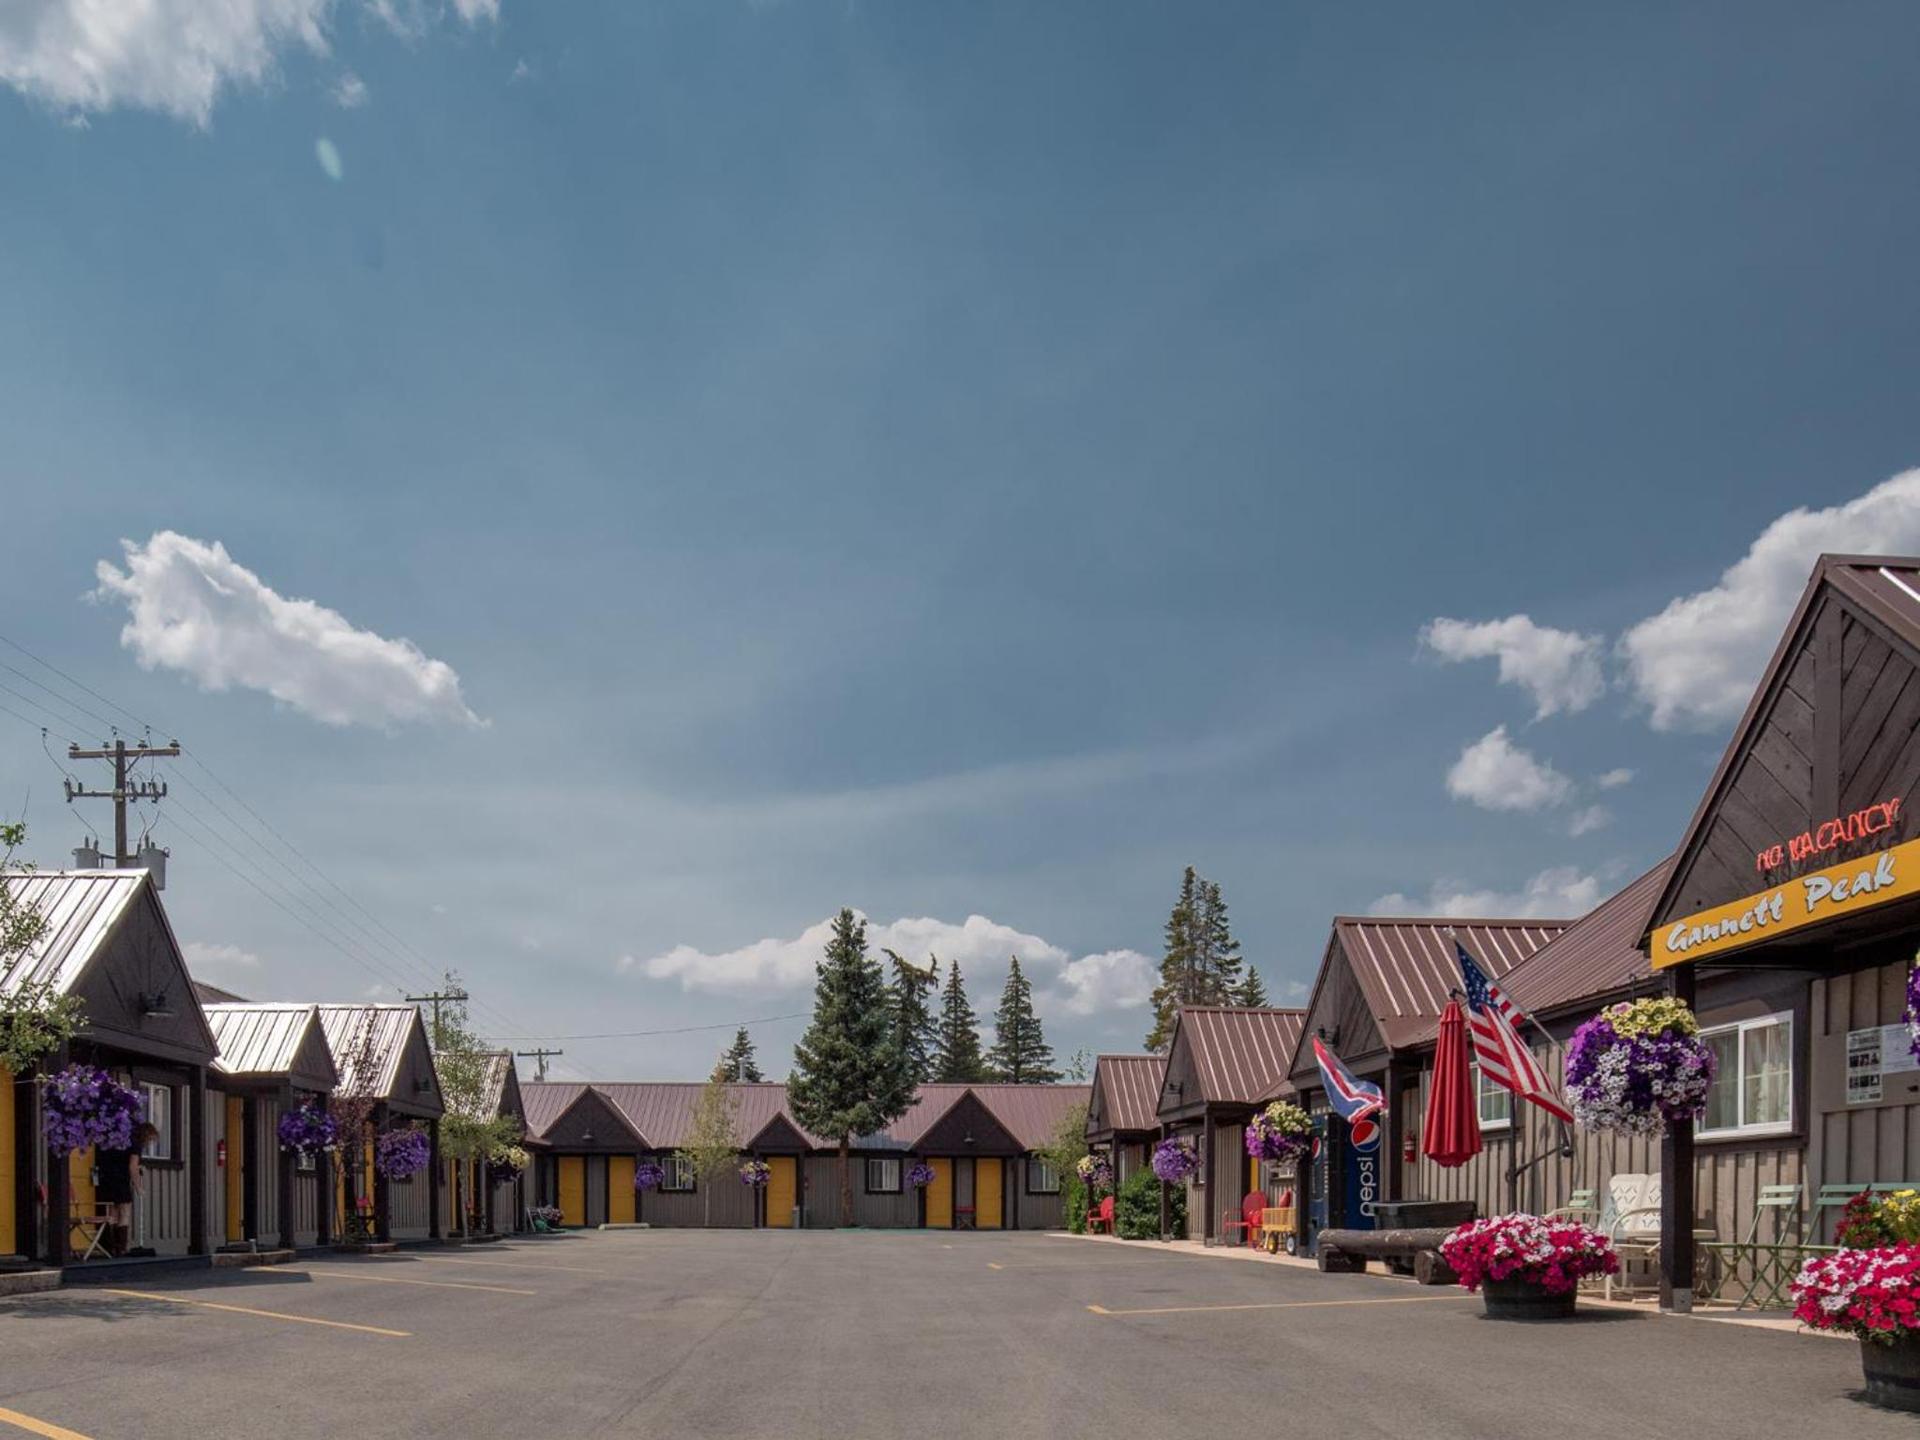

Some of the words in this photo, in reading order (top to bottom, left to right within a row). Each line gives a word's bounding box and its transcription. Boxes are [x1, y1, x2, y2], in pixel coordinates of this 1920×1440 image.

[1756, 845, 1783, 872] NO
[1789, 798, 1900, 861] VACANCY
[1667, 893, 1783, 952] Gannett
[1804, 852, 1896, 913] Peak
